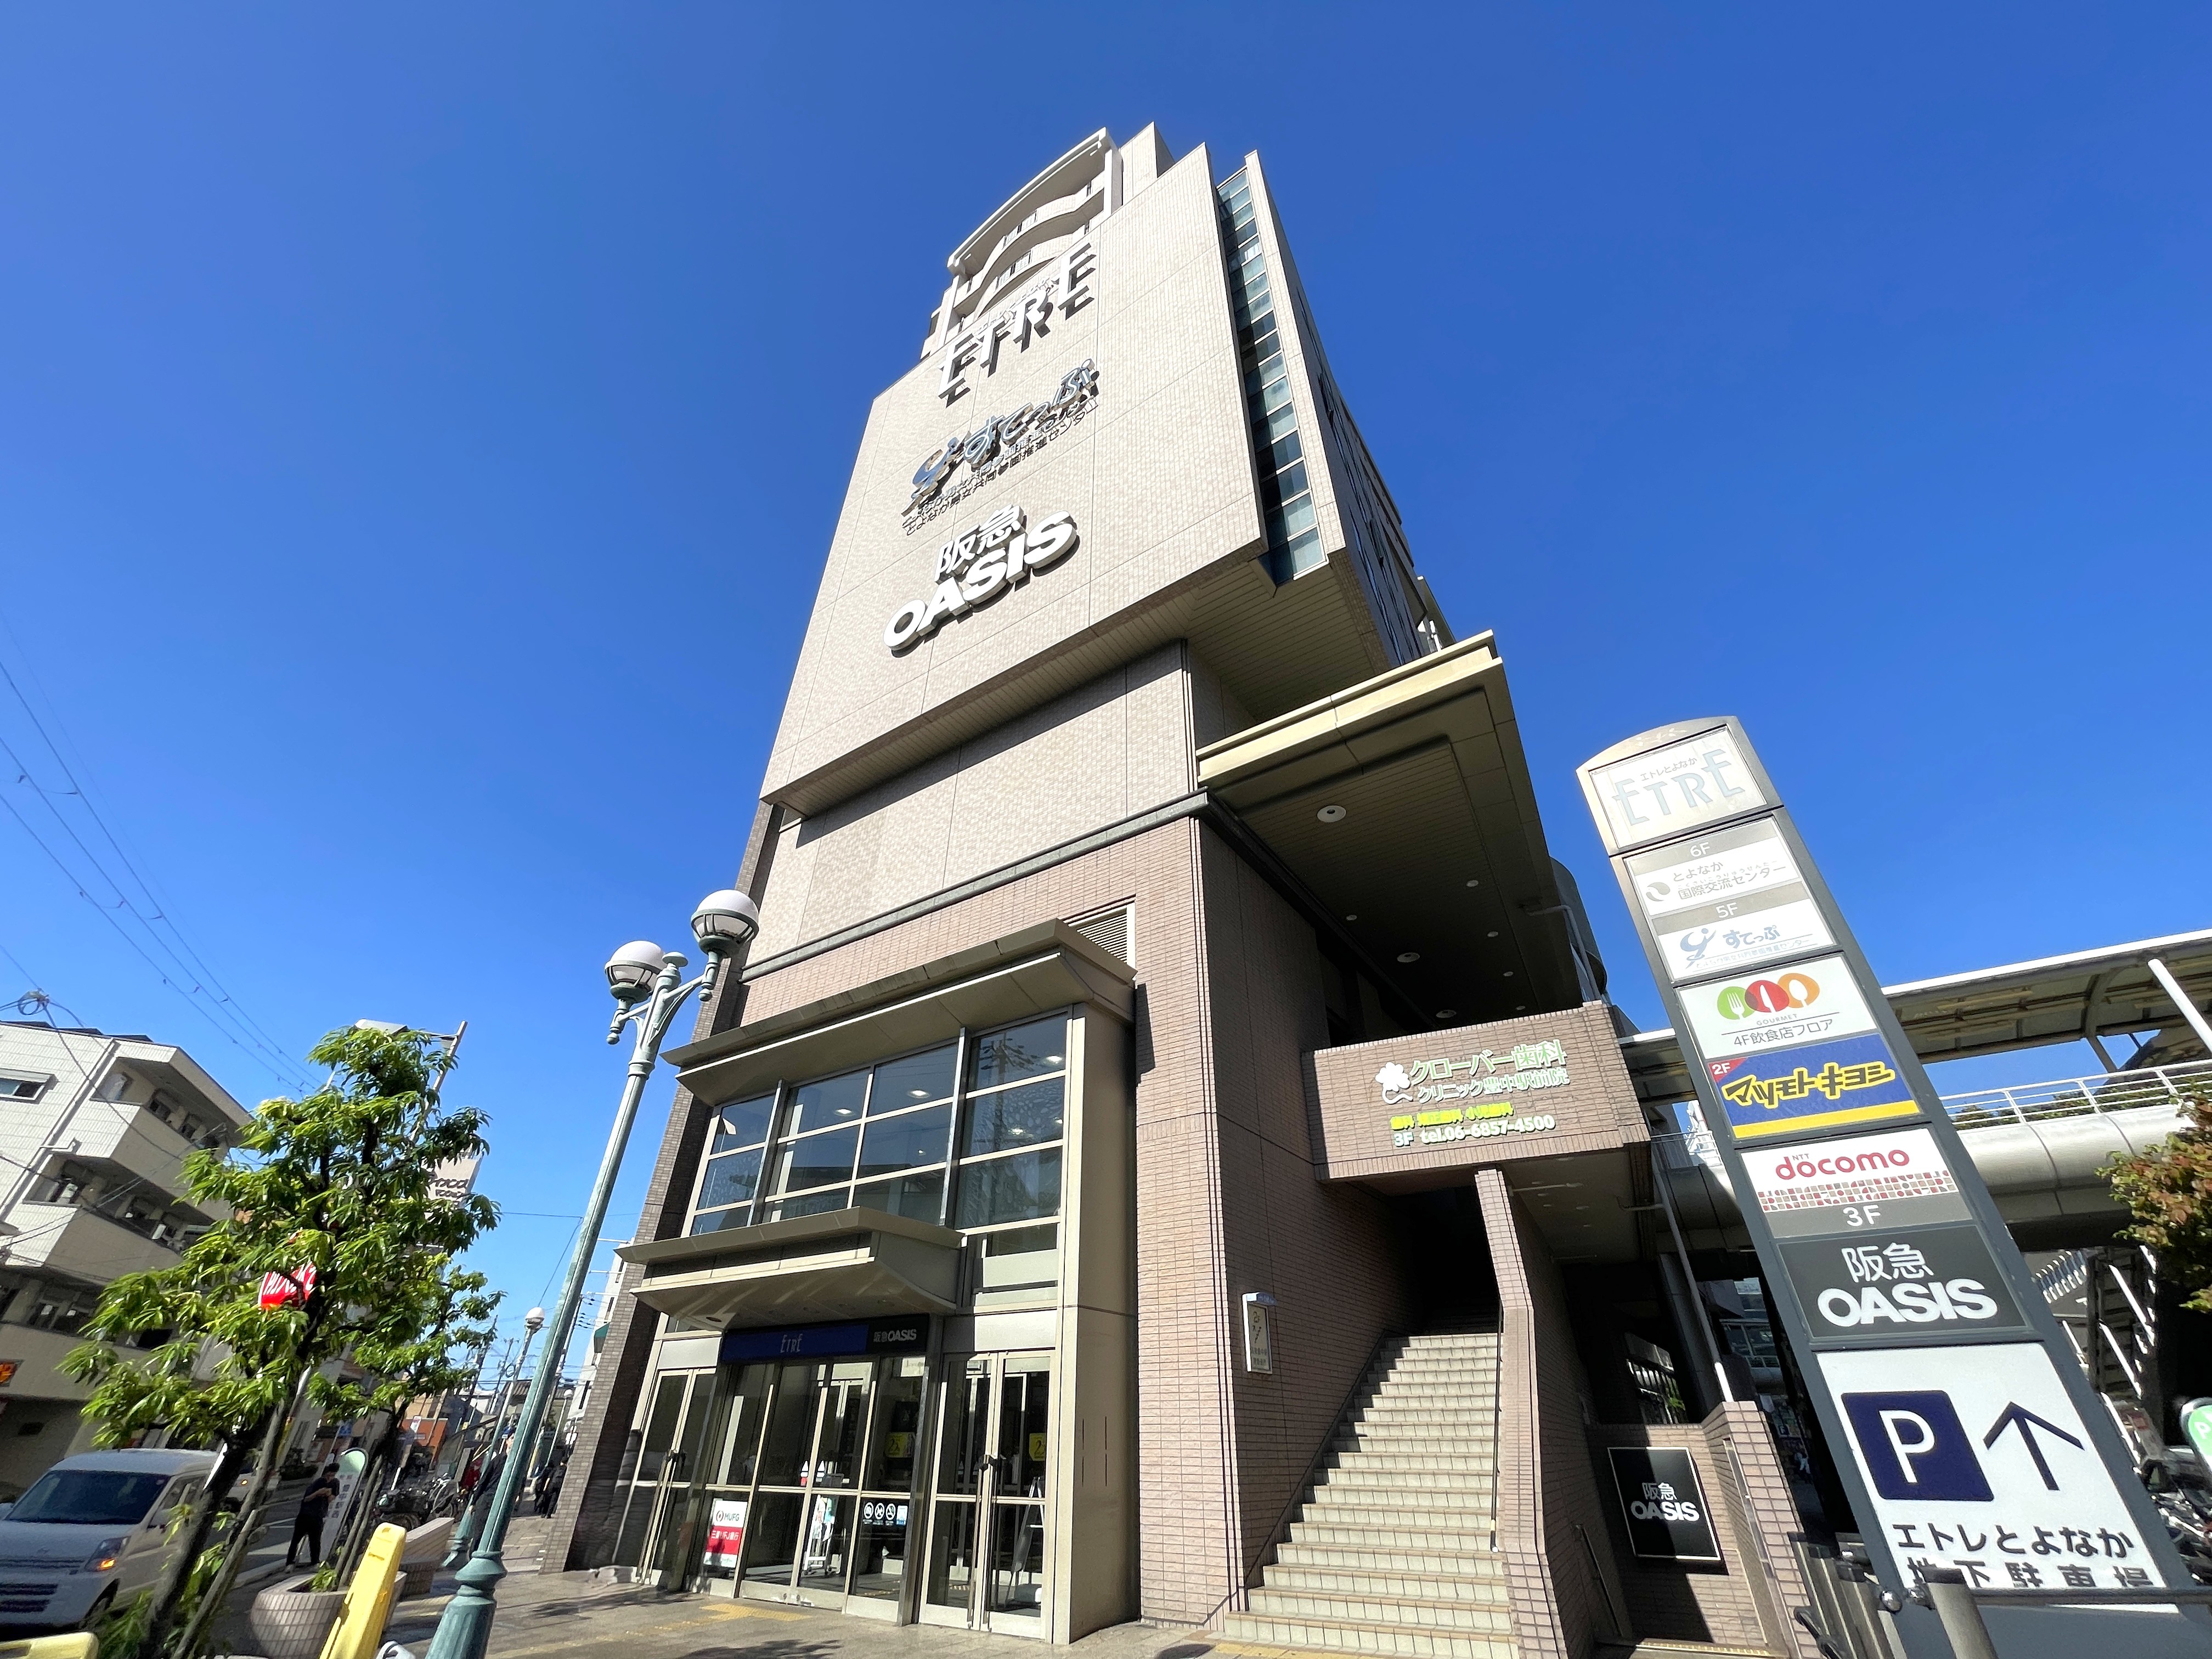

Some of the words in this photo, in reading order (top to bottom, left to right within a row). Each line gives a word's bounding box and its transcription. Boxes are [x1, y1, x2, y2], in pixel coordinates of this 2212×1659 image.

[938, 242, 1096, 399] ETRE
[963, 358, 1096, 464] すてっぷ
[934, 503, 1024, 584] 阪急
[883, 510, 1077, 649] OASIS
[1640, 757, 1697, 781] エトレとよなか
[1612, 748, 1746, 826] ETRE
[1689, 842, 1711, 857] 6F
[1673, 861, 1723, 882] とよなか
[1678, 866, 1786, 900] 国際交流センター
[1716, 902, 1738, 918] 5F
[1722, 924, 1781, 949] すてっぷ
[1733, 1019, 1833, 1047] 4F飲食店フロア
[1756, 1013, 1798, 1026] GOURMET
[1408, 1039, 1568, 1085] クローバー歯科
[1711, 1062, 1731, 1075] 2F
[1416, 1067, 1571, 1104] クリニック豊中駅前院
[1722, 1060, 1896, 1109] マツモトキヨシ
[1393, 1132, 1414, 1147] 3F
[1419, 1114, 1556, 1144] tel.06-6857-4500
[1775, 1149, 1910, 1180] docomo
[1792, 1153, 1810, 1161] NTT
[1843, 1205, 1881, 1227] 3F
[1841, 1242, 1934, 1283] 阪急
[1816, 1278, 1999, 1327] OASIS
[1878, 1409, 1936, 1484] P
[1641, 1482, 1677, 1501] 阪急
[724, 1512, 740, 1521] MUFG
[1630, 1500, 1700, 1522] OASIS
[1892, 1523, 2134, 1559] エトレとよなか
